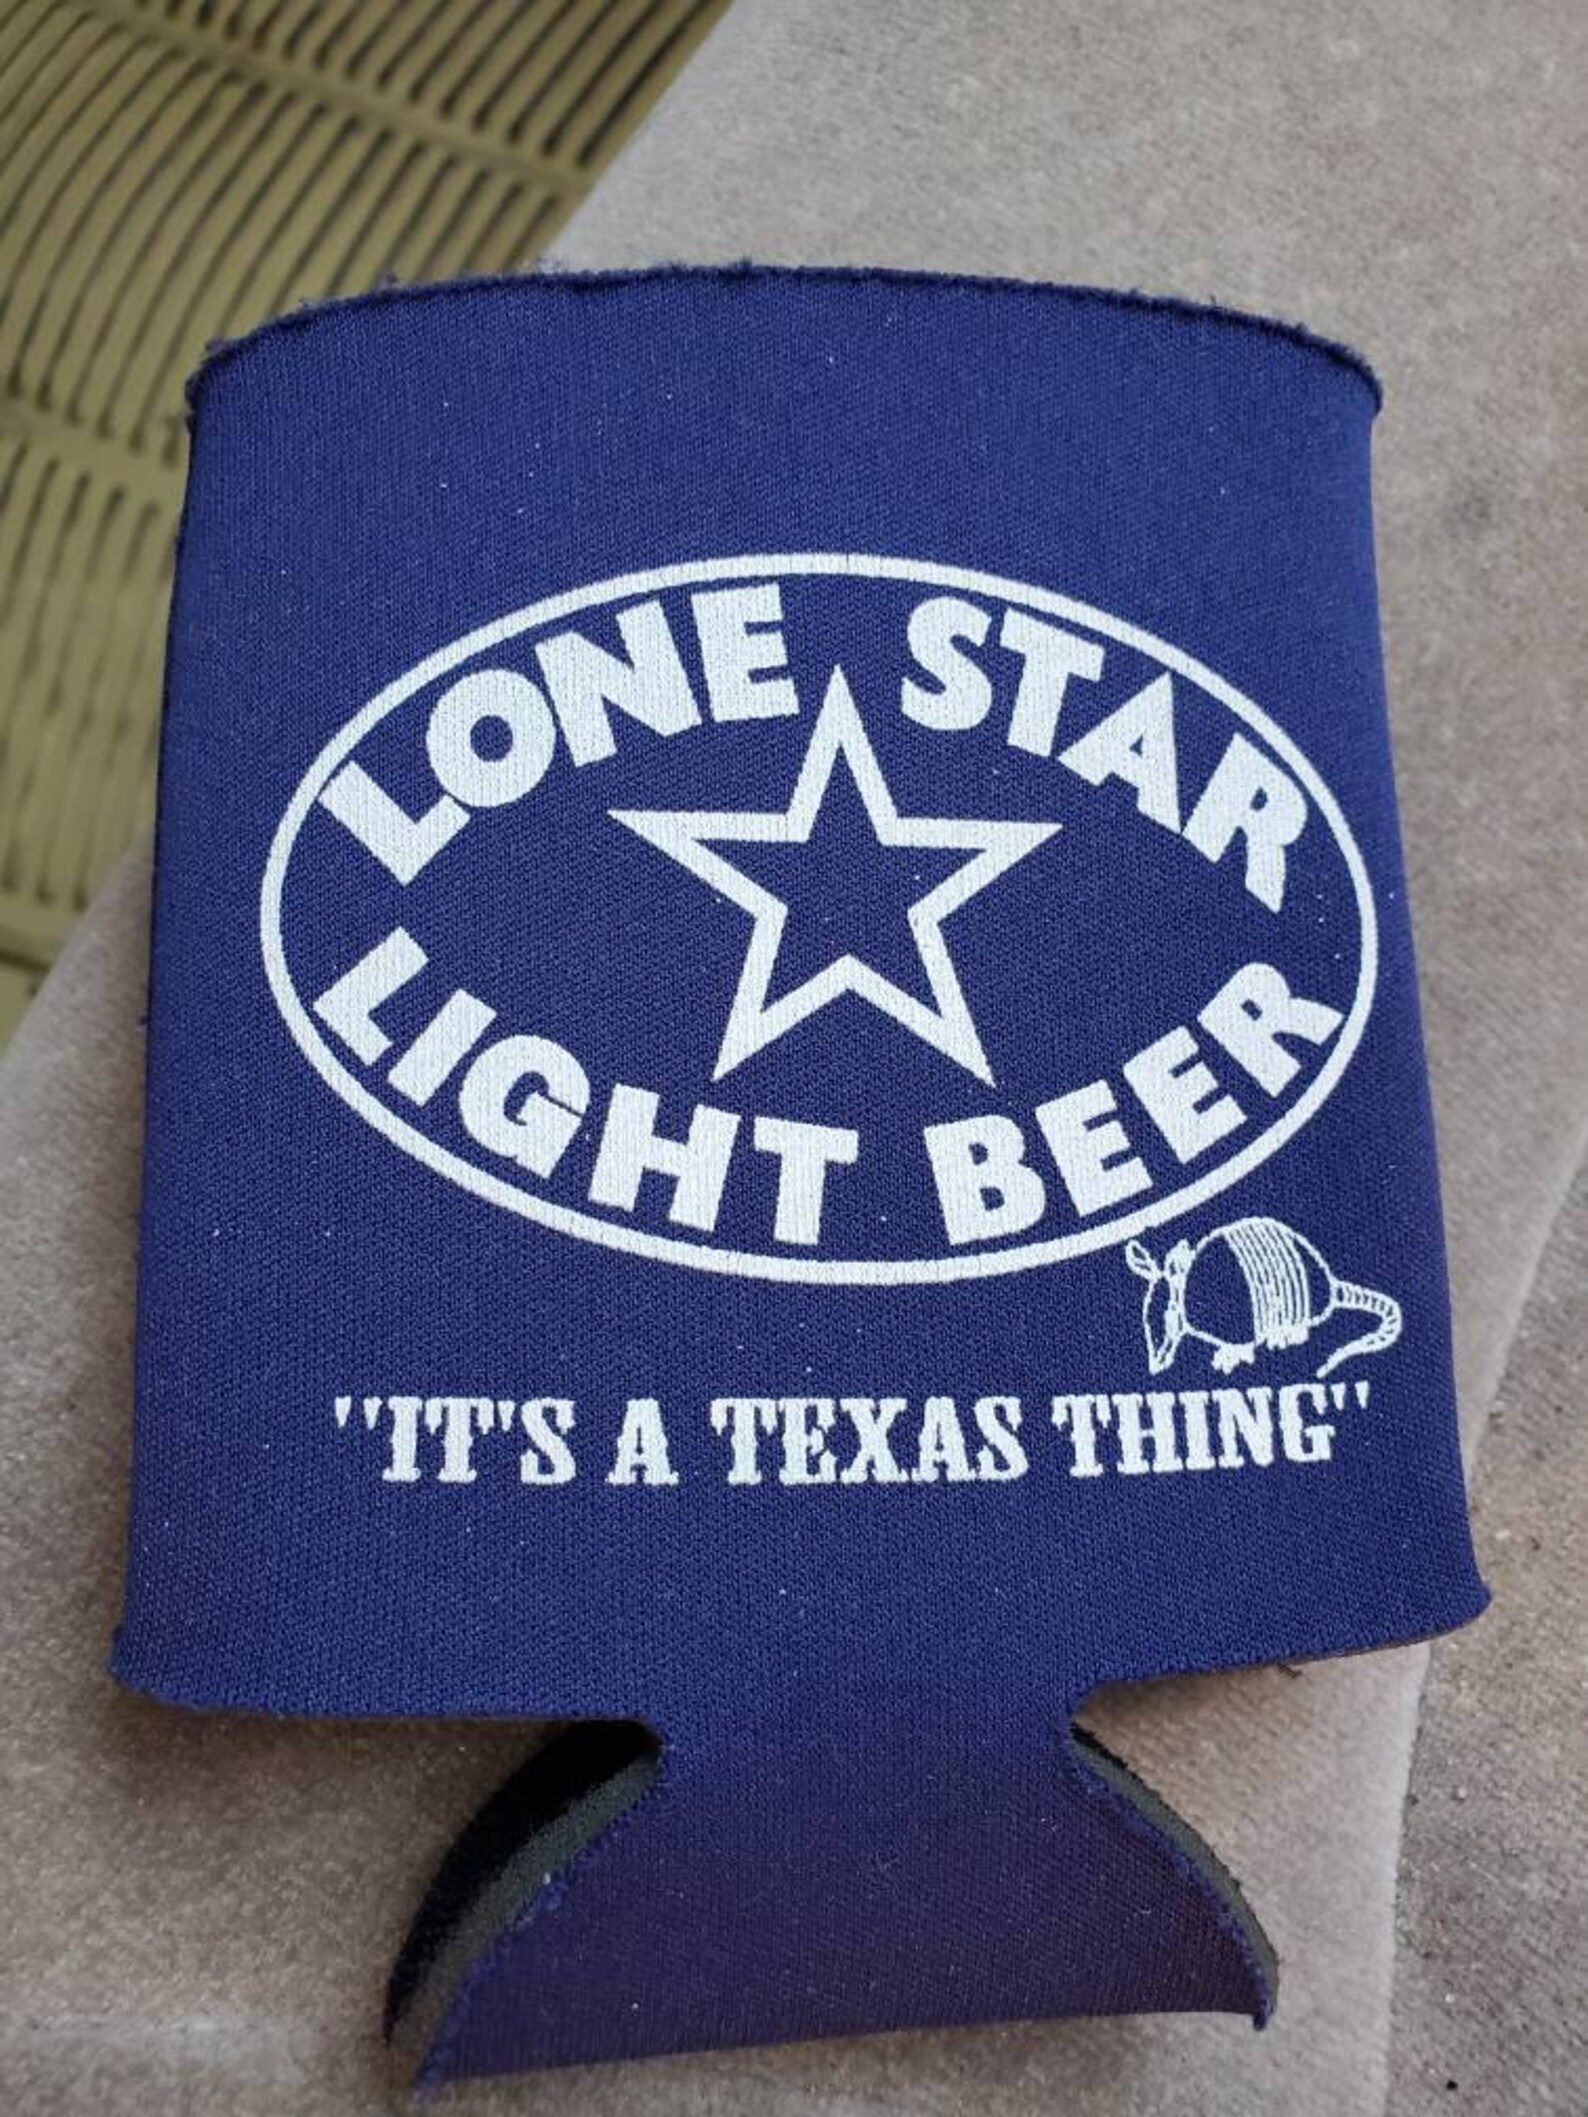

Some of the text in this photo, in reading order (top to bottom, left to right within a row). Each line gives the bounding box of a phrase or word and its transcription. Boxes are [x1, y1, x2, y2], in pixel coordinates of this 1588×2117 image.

[317, 582, 1308, 913] LONE STAR
[312, 926, 1344, 1246] LIGHT BEER
[604, 1397, 680, 1487] A
[709, 1395, 1029, 1487] TEXAS
